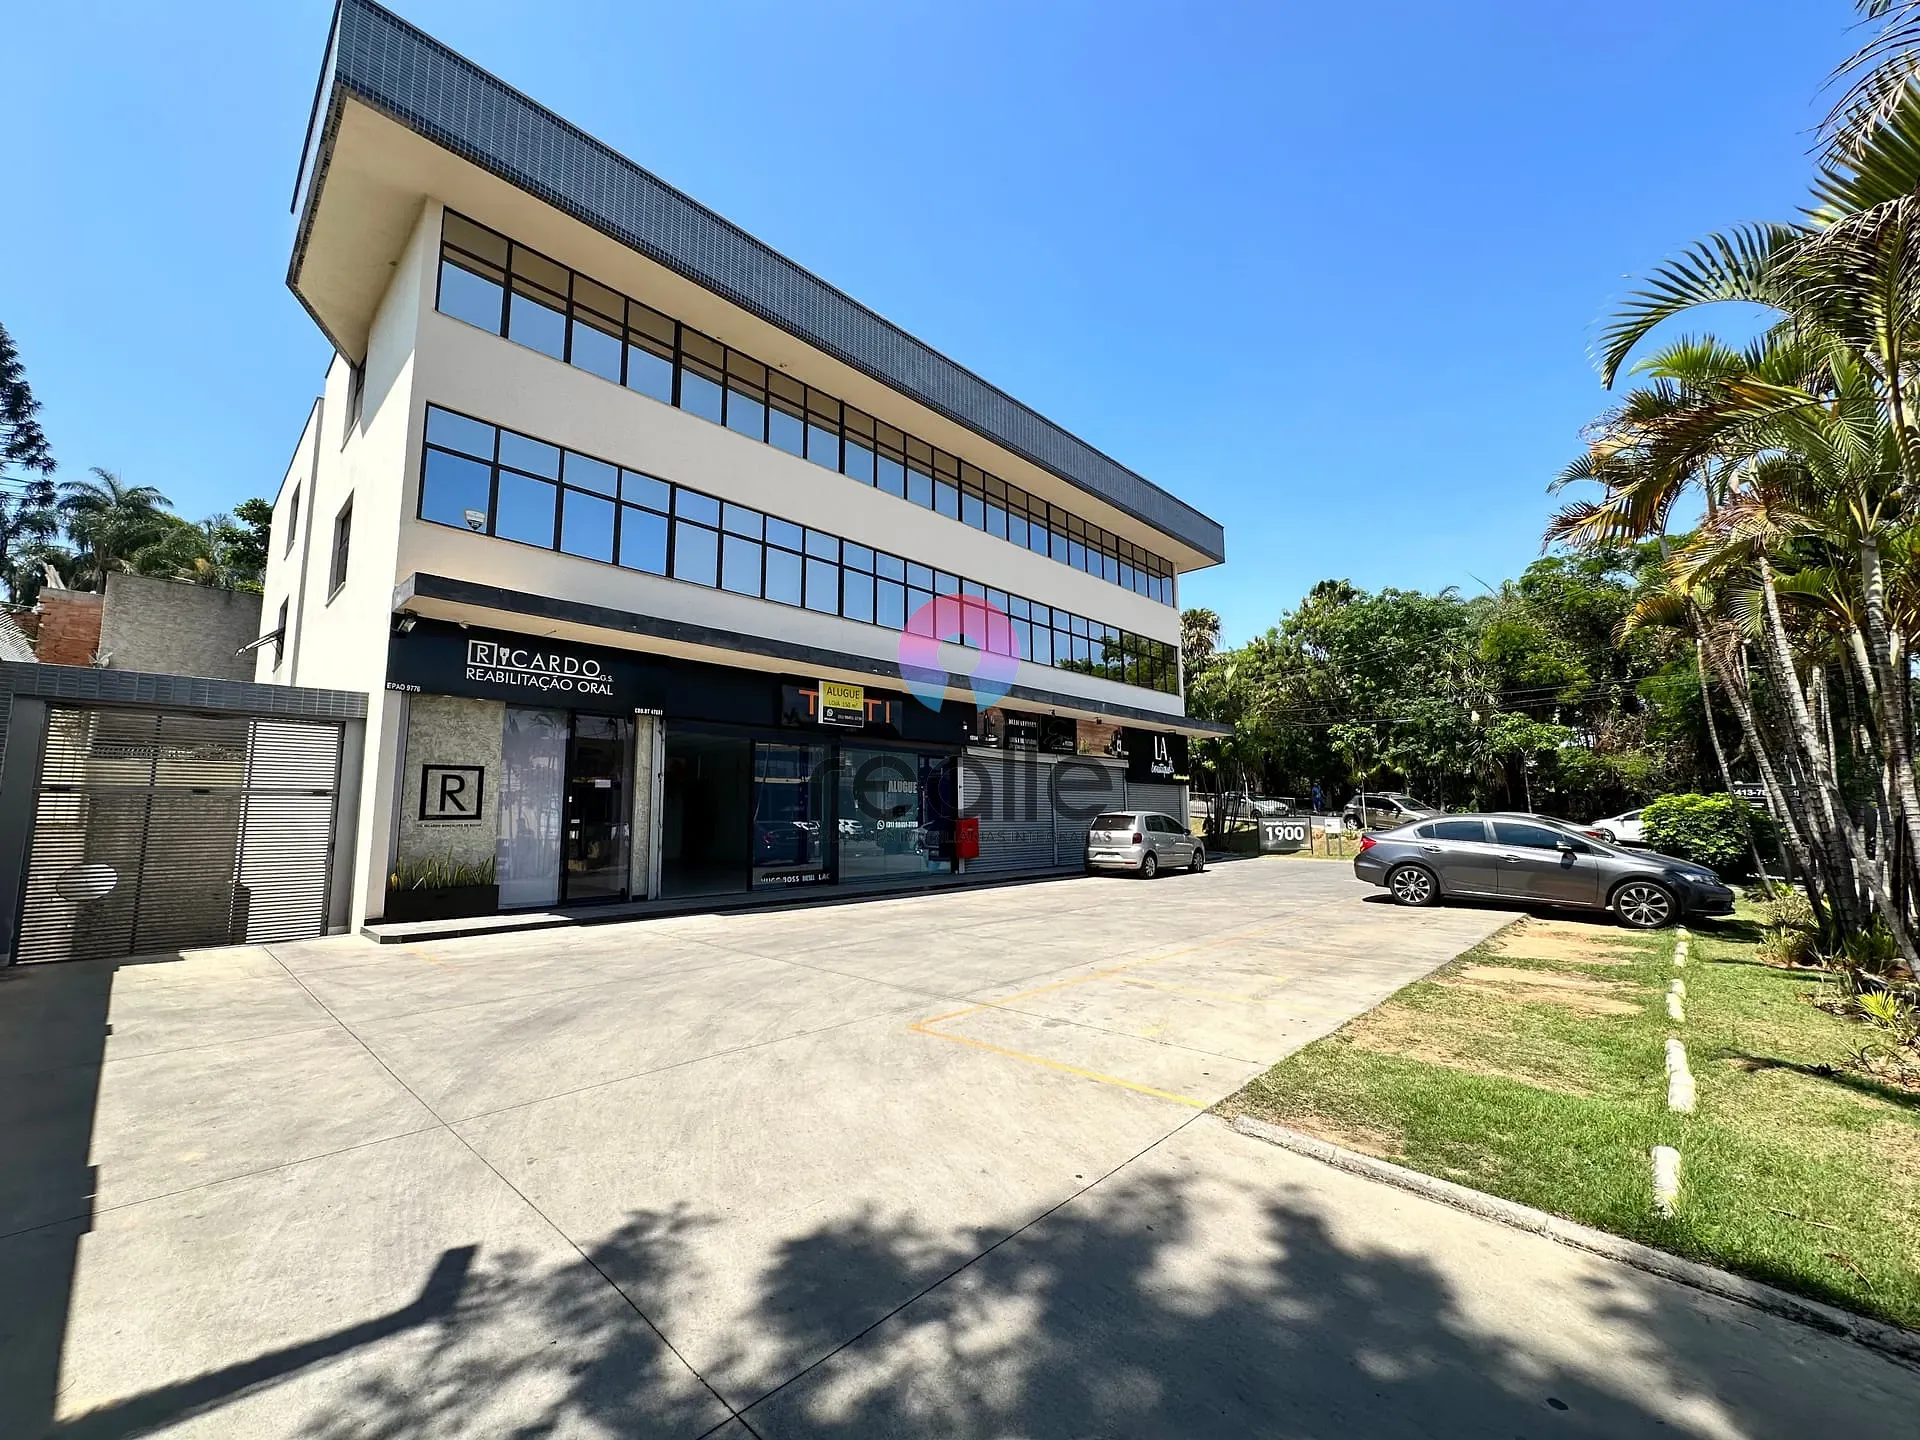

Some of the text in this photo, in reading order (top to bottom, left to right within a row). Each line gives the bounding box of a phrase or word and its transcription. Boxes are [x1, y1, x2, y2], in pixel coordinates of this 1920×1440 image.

[466, 667, 614, 696] REABILITAÇÃO ORAL
[826, 687, 860, 700] ALUGUE
[798, 689, 890, 724] TTI
[1154, 735, 1168, 761] LA
[439, 774, 467, 812] R
[887, 780, 918, 794] ALUGUE
[1265, 826, 1305, 841] 1900
